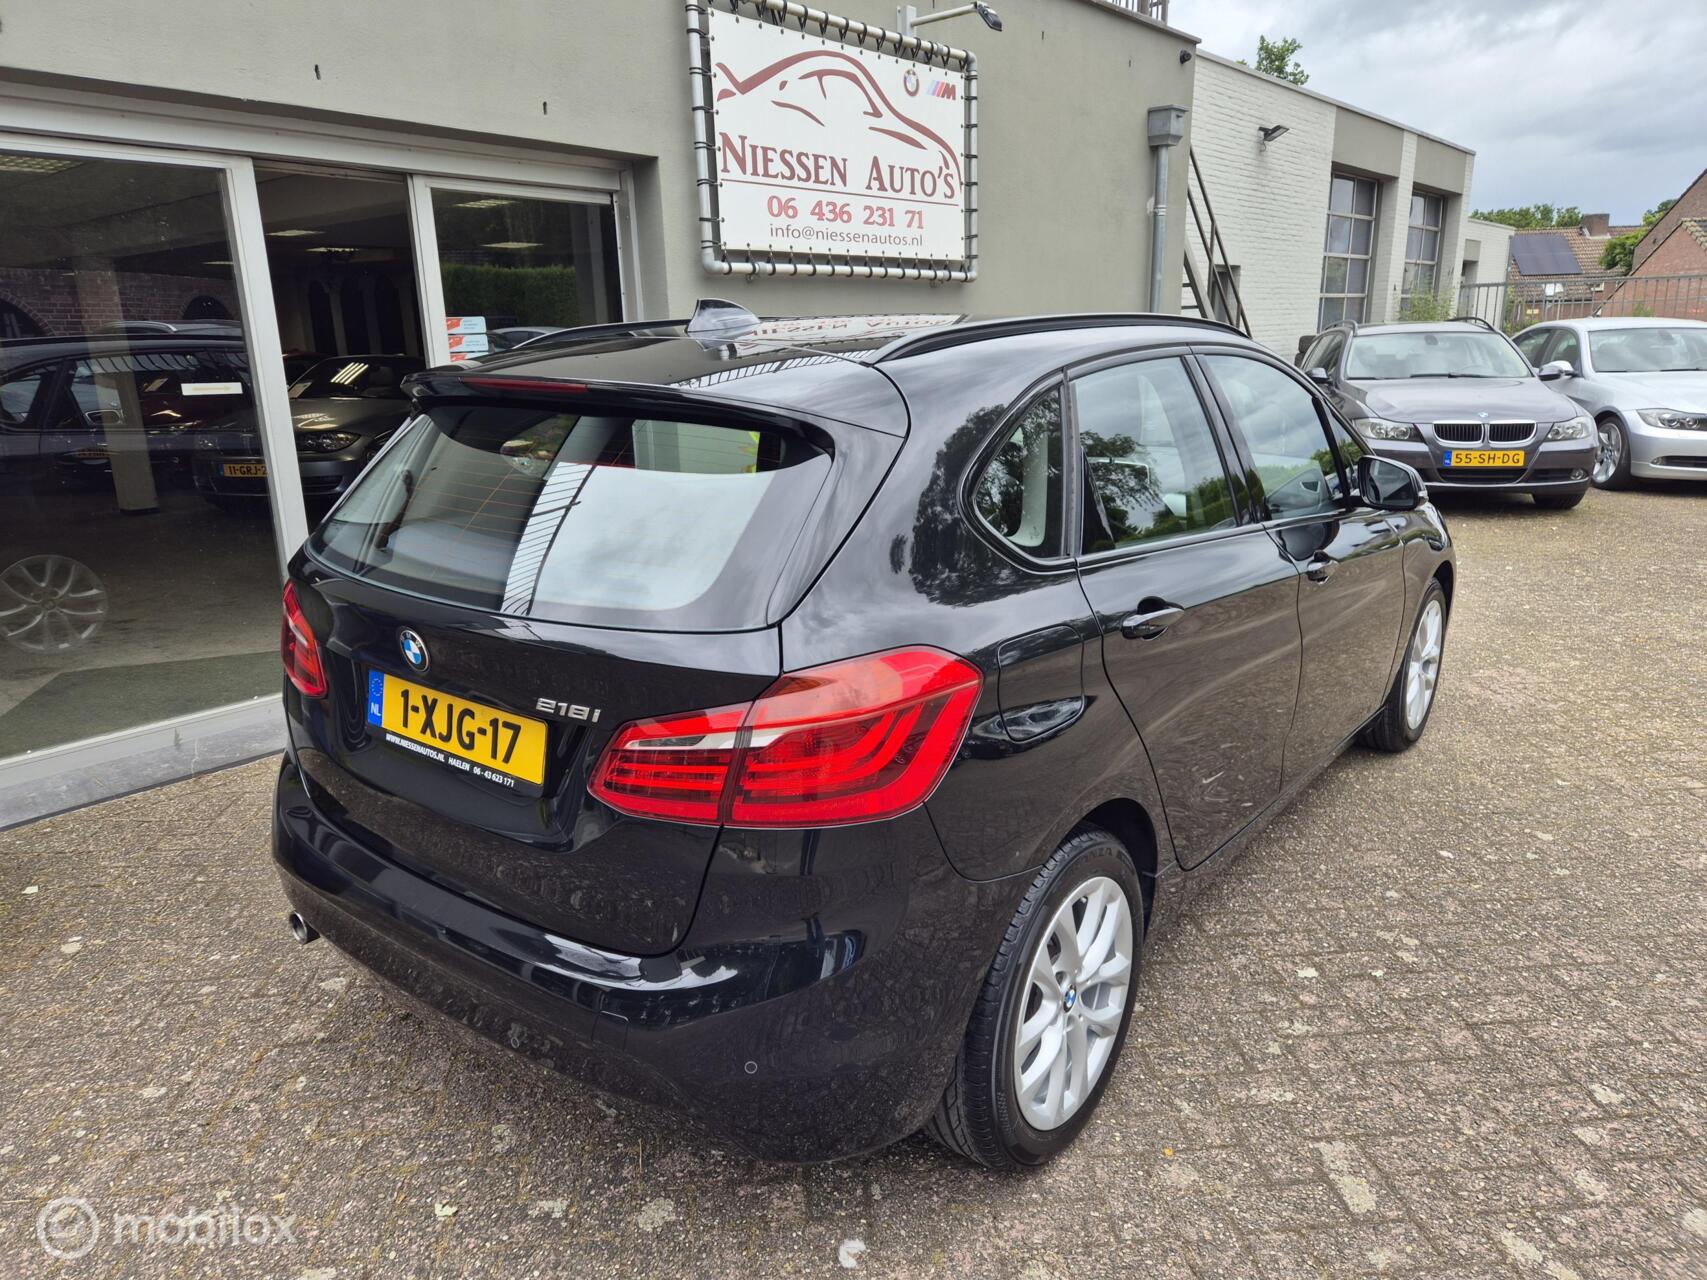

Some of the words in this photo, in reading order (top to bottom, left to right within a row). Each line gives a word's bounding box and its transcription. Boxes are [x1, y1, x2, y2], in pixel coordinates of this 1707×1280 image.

[719, 131, 848, 188] NIESSEN
[865, 155, 956, 200] AUTO'S
[767, 195, 798, 219] 06
[810, 200, 852, 224] 436
[863, 205, 896, 228] 231
[904, 210, 924, 230] 71
[769, 223, 924, 247] info@niessenautos.nl
[1455, 453, 1520, 464] 55-SH-DG
[370, 702, 381, 717] NL
[535, 698, 601, 723] 218i
[400, 689, 522, 765] 1-XJG-17
[385, 733, 445, 762] WWW.NIESSENAUTOS.NL
[448, 757, 470, 771] HAELEN
